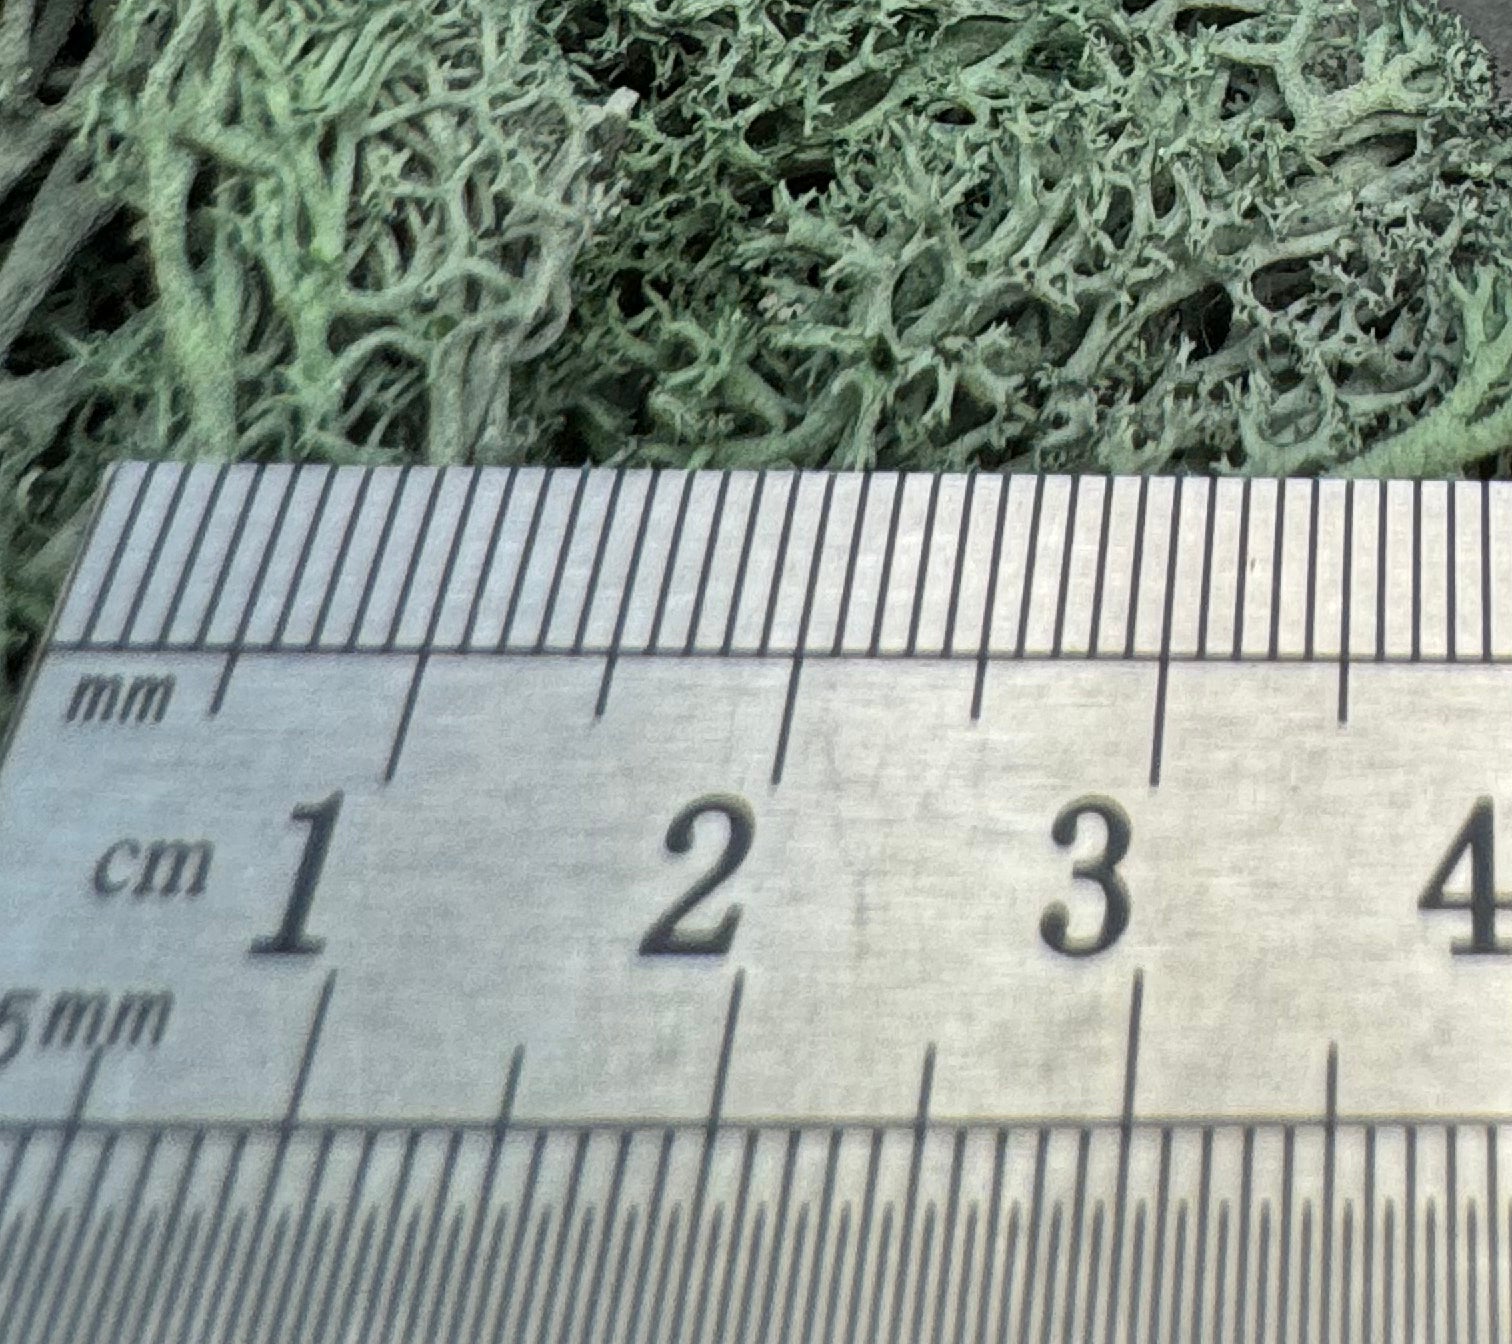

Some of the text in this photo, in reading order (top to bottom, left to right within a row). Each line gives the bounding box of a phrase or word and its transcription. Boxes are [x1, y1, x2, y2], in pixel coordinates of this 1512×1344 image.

[66, 672, 177, 725] mm
[92, 837, 215, 898] cm
[247, 788, 345, 954] 1
[638, 792, 757, 957] 2
[1038, 793, 1133, 958] 3
